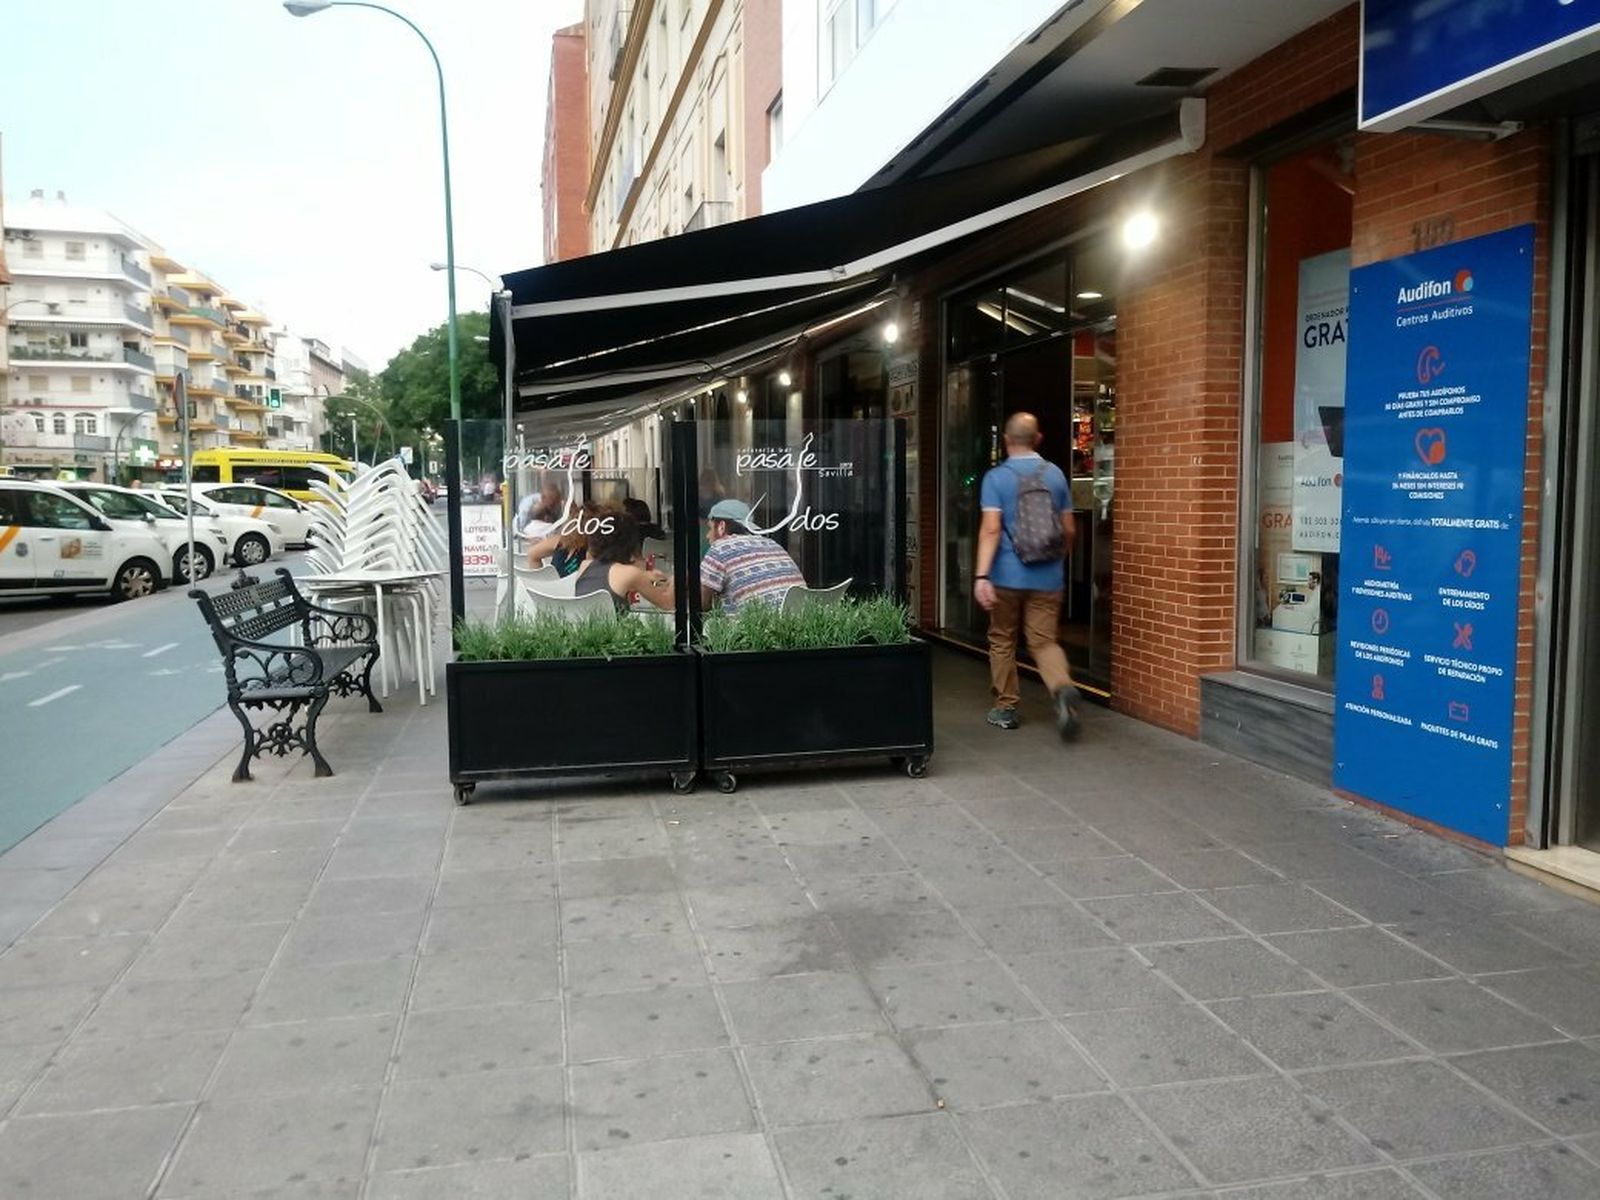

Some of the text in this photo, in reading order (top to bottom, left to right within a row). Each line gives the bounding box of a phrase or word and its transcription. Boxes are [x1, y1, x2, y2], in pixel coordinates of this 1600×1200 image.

[1397, 279, 1452, 304] Audifon
[1396, 305, 1473, 327] Centros Auditivos
[1304, 321, 1346, 348] GRA
[1440, 395, 1481, 405] COMPROMISO
[1424, 407, 1464, 416] COMPRARLOS
[819, 468, 854, 478] Sevilla
[1408, 491, 1445, 499] COMISIONES
[561, 509, 616, 537] dos
[790, 506, 840, 532] dos
[1262, 512, 1293, 529] GRA
[1431, 517, 1475, 528] TOTALMENTE
[1475, 519, 1500, 529] GRATIS
[1438, 586, 1490, 601] ENTRENAMIENTO
[1442, 597, 1485, 610] DE LOS OÍDOS
[1423, 654, 1503, 677] SERVICIO TÉCNICO PROPIO
[1437, 667, 1447, 676] DE
[1345, 702, 1370, 715] ATENCIÓN
[1421, 722, 1450, 736] PAQUETES
[1459, 731, 1476, 744] PILAS
[1476, 736, 1499, 750] GRATIS
